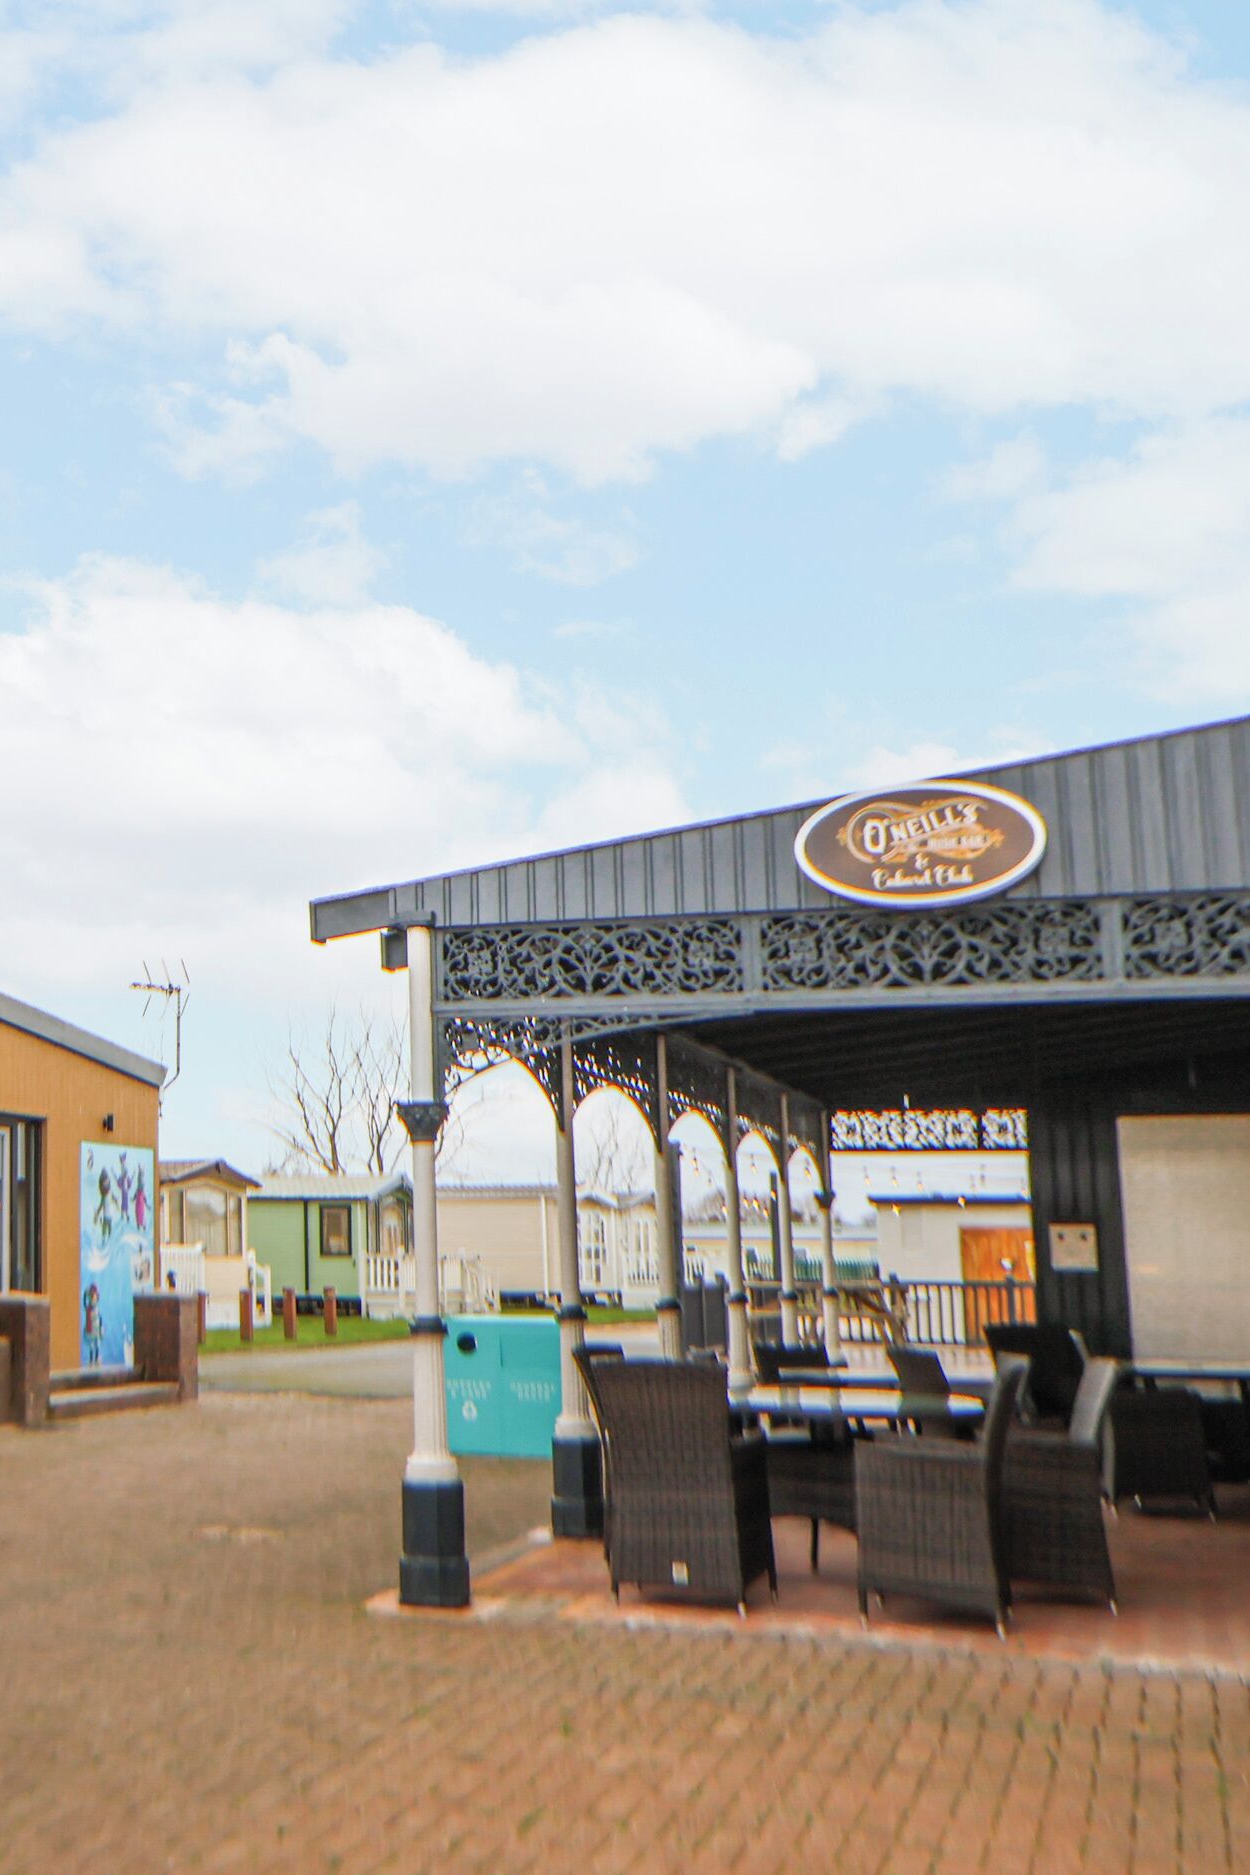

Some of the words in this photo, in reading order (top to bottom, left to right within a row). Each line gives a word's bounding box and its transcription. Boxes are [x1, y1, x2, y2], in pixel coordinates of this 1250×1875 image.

[863, 802, 979, 855] O'NEILL'S
[914, 852, 930, 871] &
[934, 864, 975, 888] Club
